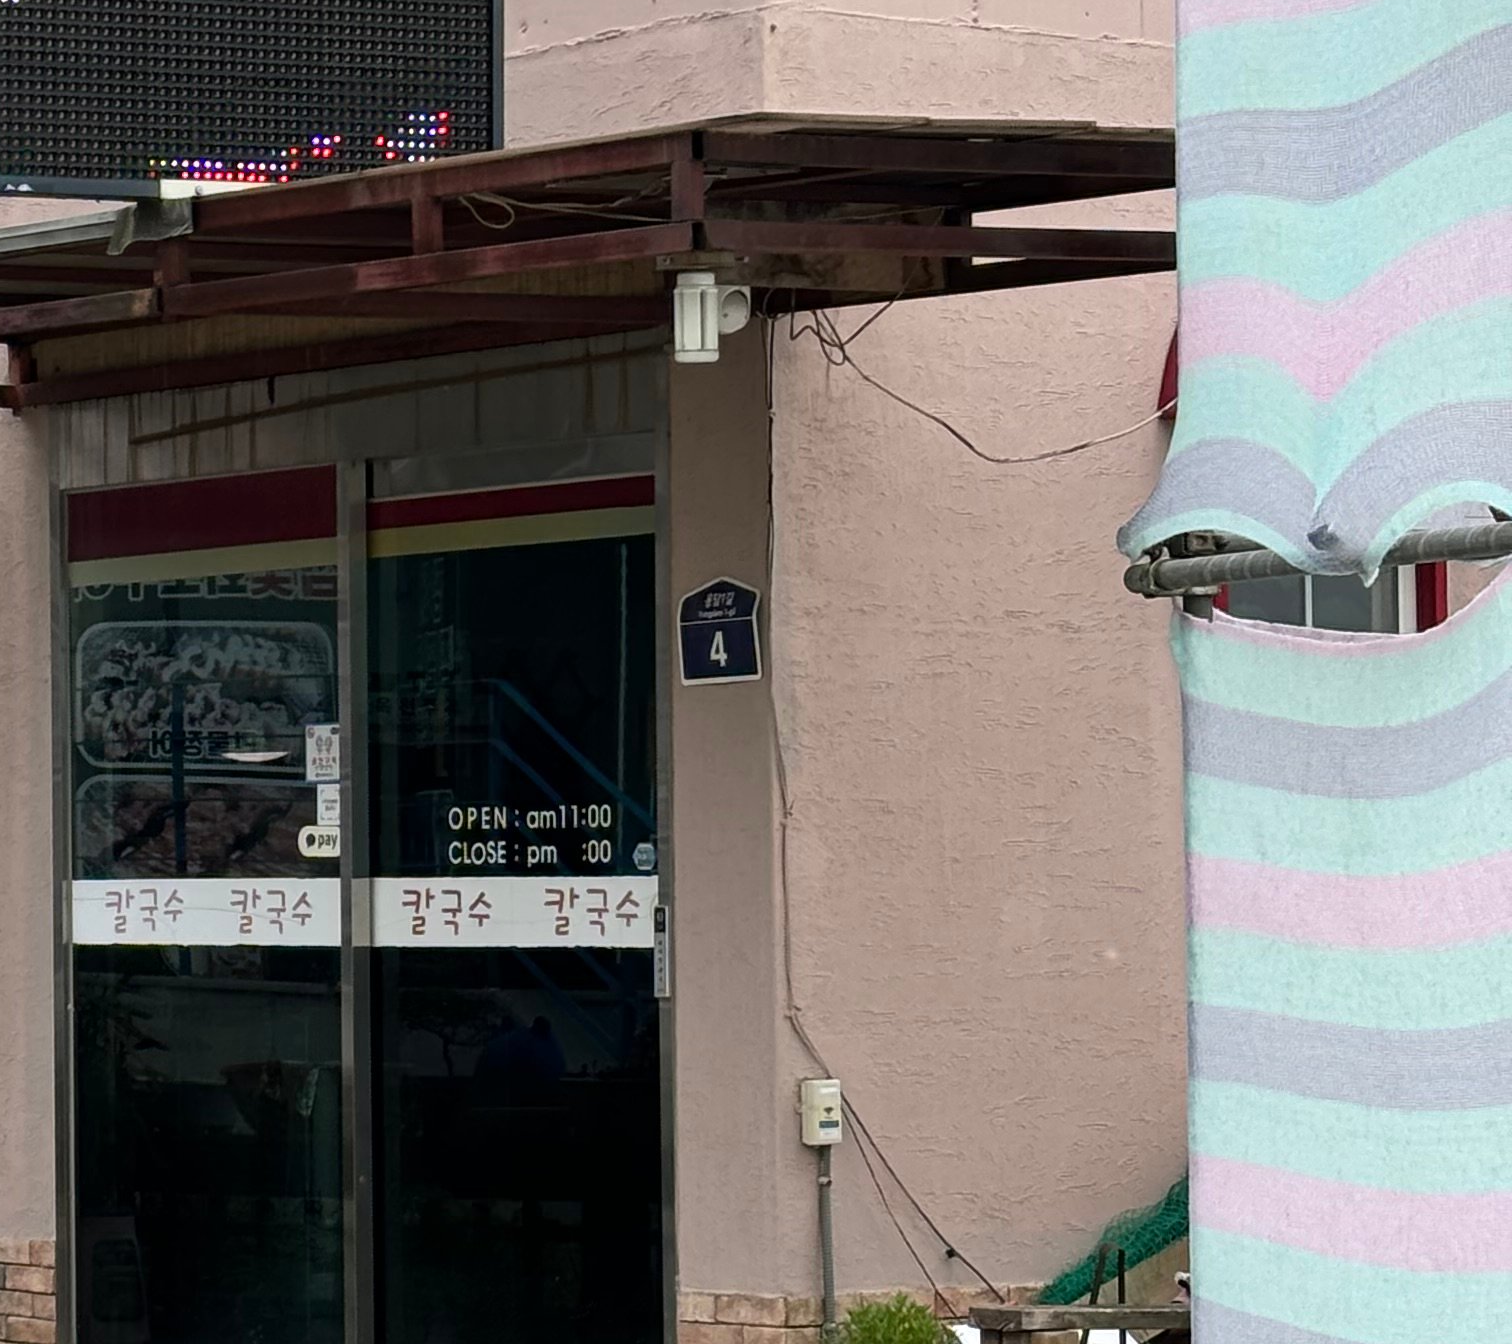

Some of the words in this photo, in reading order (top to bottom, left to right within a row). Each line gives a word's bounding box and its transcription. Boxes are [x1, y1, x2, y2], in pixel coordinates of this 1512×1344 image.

[710, 631, 727, 668] 4
[448, 807, 507, 830] OPEN
[317, 833, 338, 850] pay
[448, 840, 507, 865] CLOSE
[526, 844, 558, 868] pm
[104, 888, 185, 934] 칼국수
[230, 887, 313, 935] 칼국수
[401, 887, 493, 936] 칼국수
[543, 886, 641, 937] 칼국수
